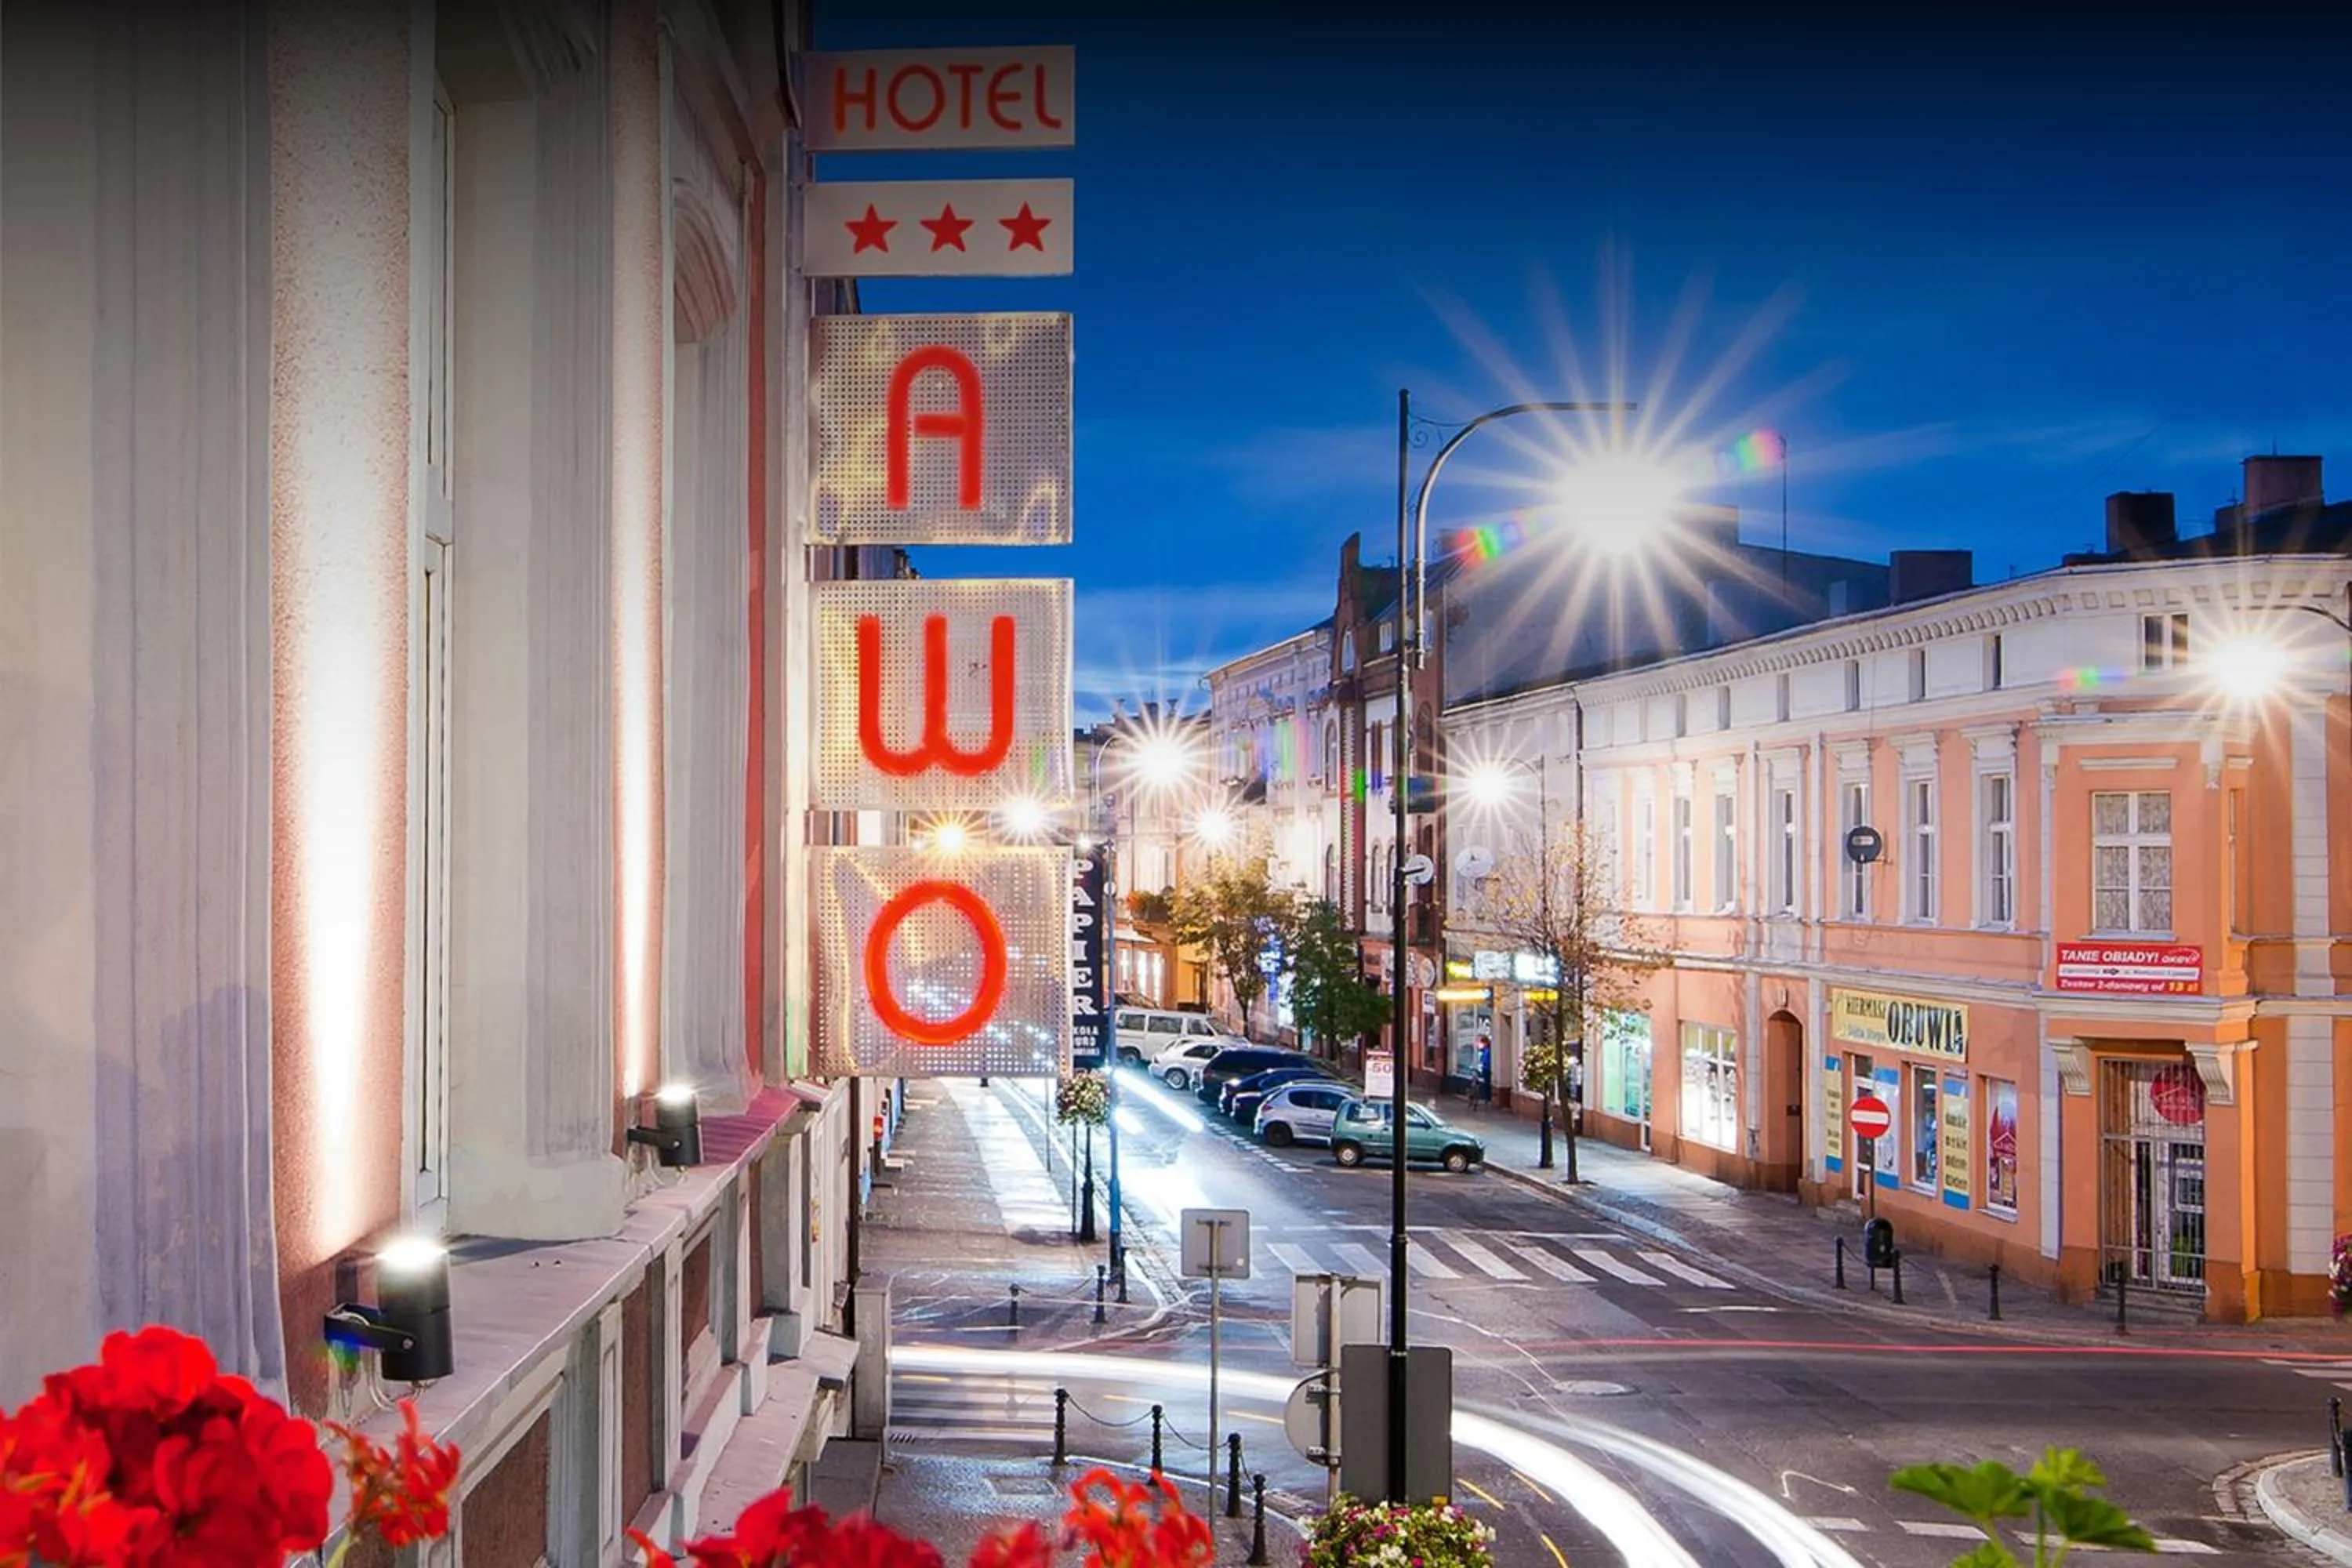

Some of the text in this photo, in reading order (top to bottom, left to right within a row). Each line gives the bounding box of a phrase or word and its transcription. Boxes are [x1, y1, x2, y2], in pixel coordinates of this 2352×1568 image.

[834, 63, 1062, 132] HOTEL
[858, 343, 1015, 1046] AWO
[2061, 949, 2100, 961] TANIE
[2103, 951, 2158, 964] OBIADY!
[1888, 1001, 1963, 1054] OBUWIA
